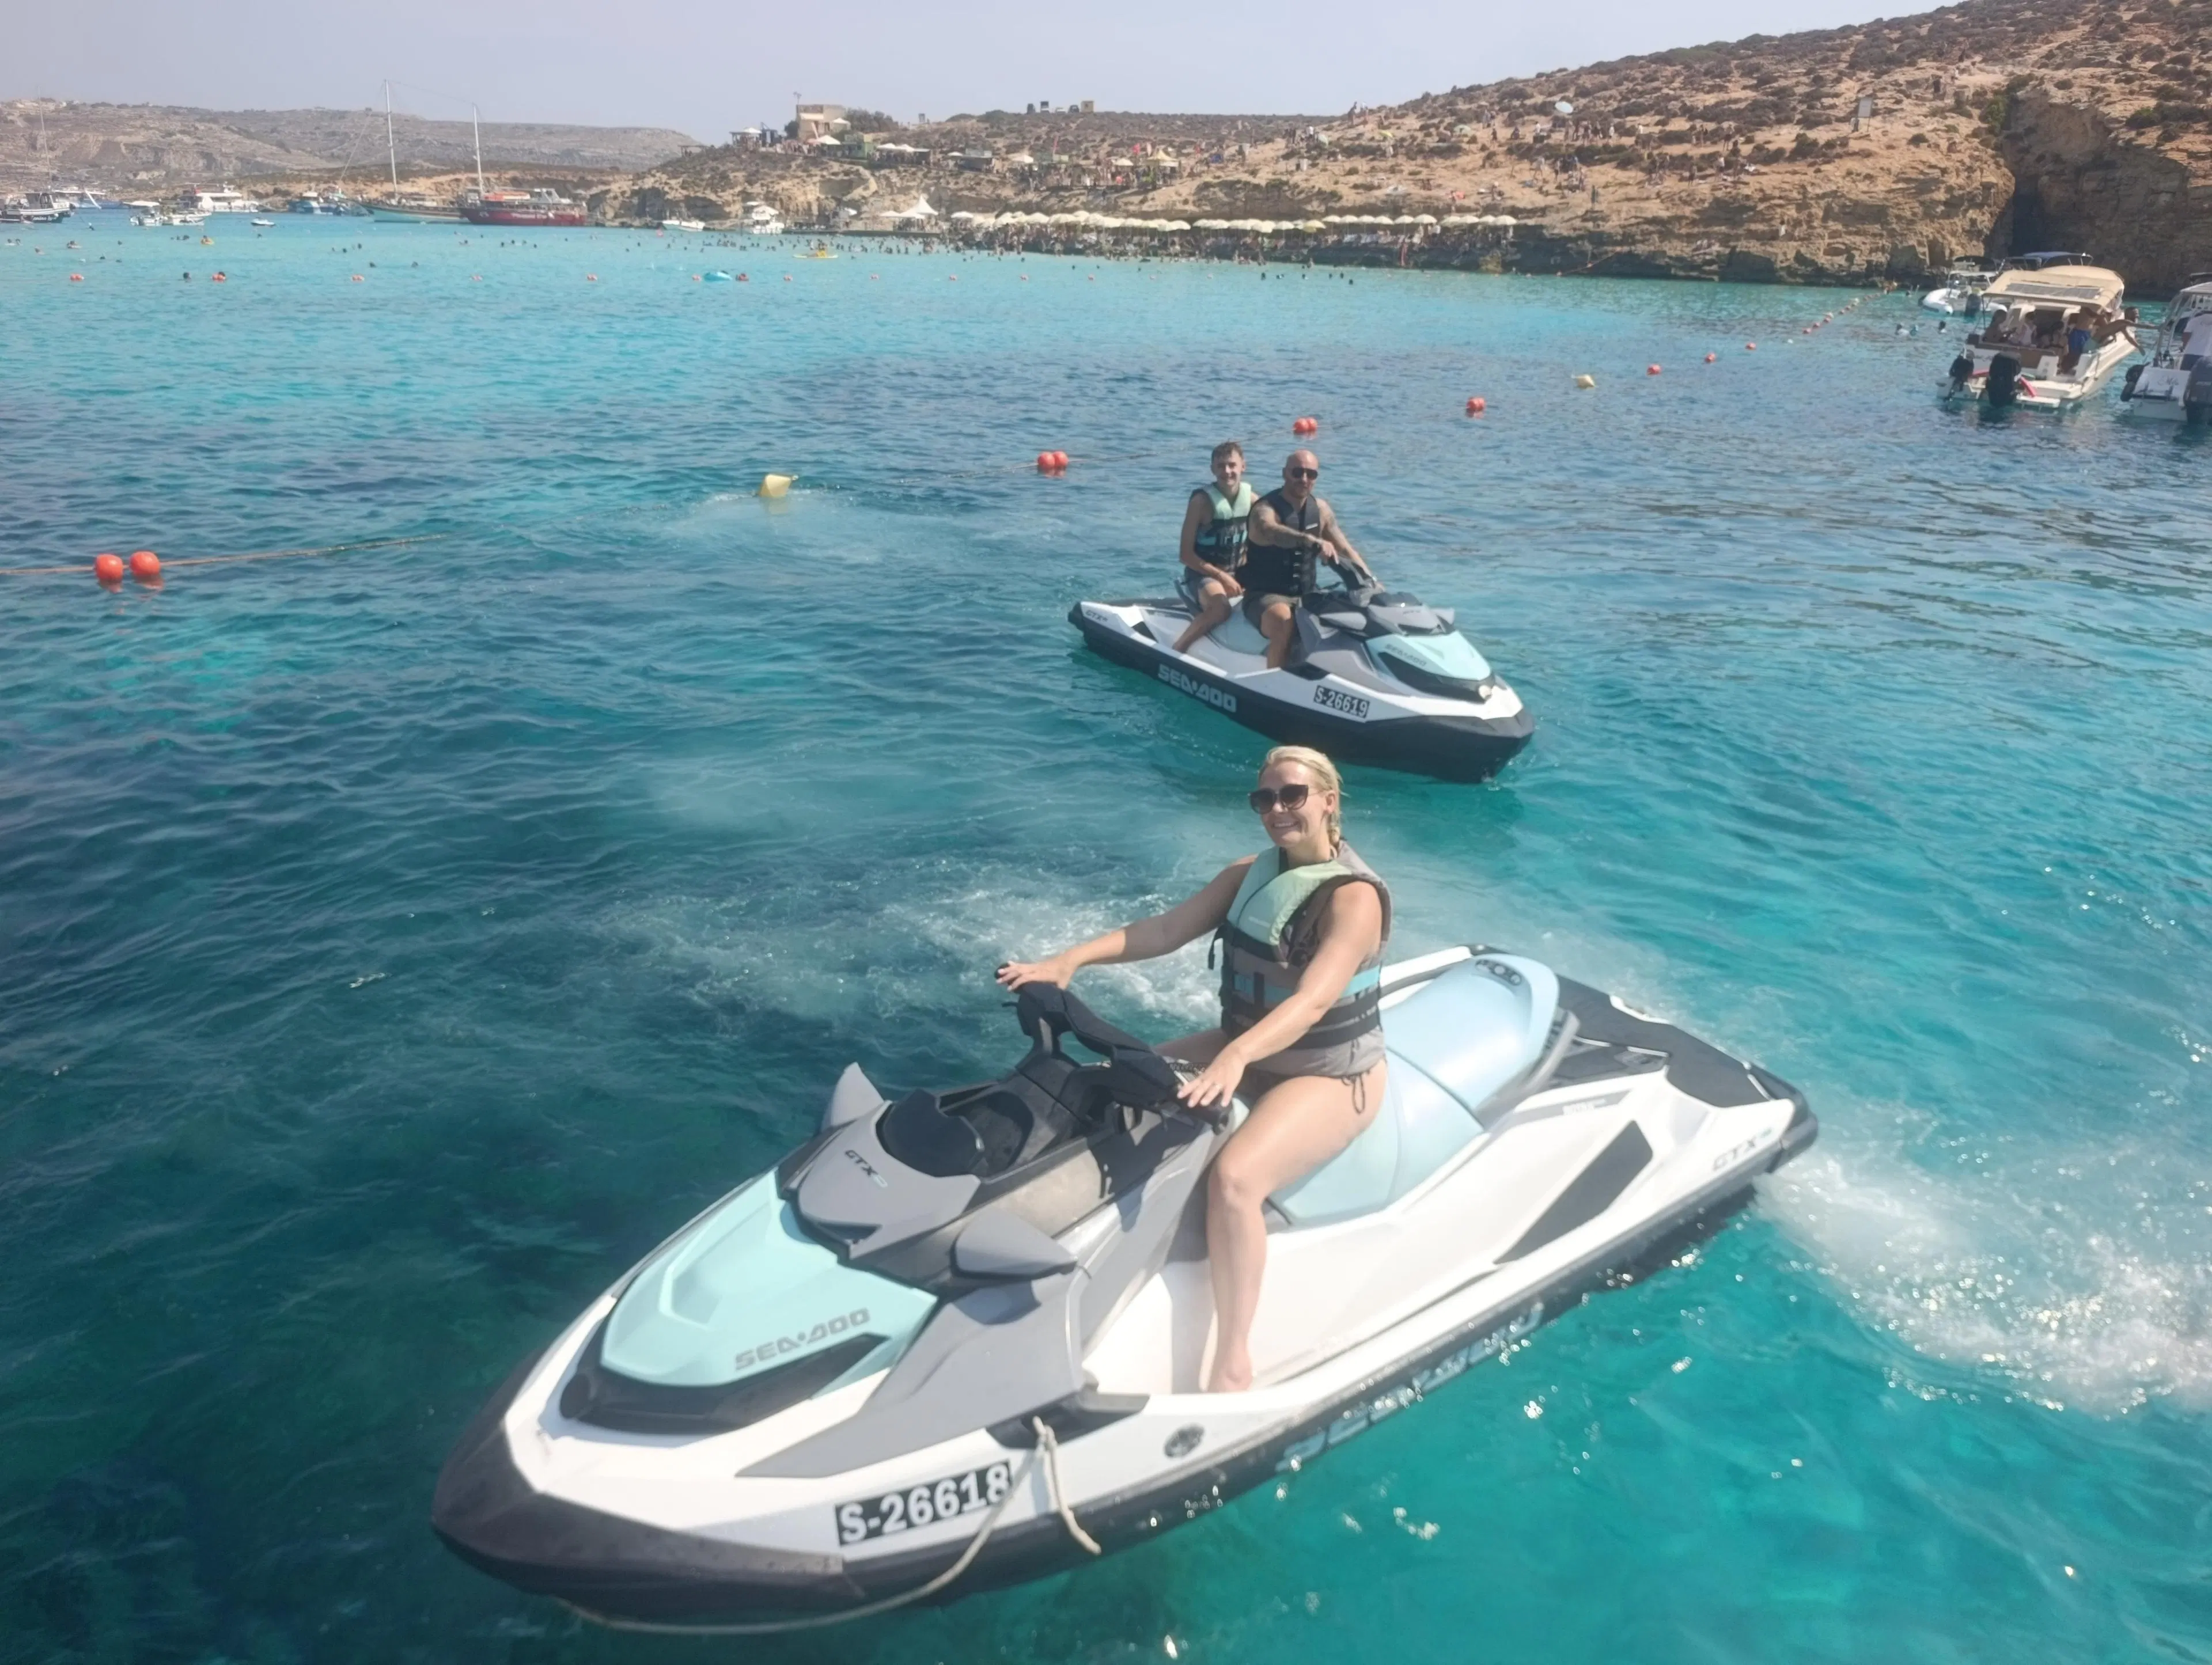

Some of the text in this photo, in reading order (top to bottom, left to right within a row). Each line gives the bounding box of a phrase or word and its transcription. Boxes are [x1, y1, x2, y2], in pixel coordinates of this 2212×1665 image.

[1315, 687, 1368, 718] S-26619
[844, 1150, 878, 1176] GTX
[839, 1463, 1009, 1543] S-26618
